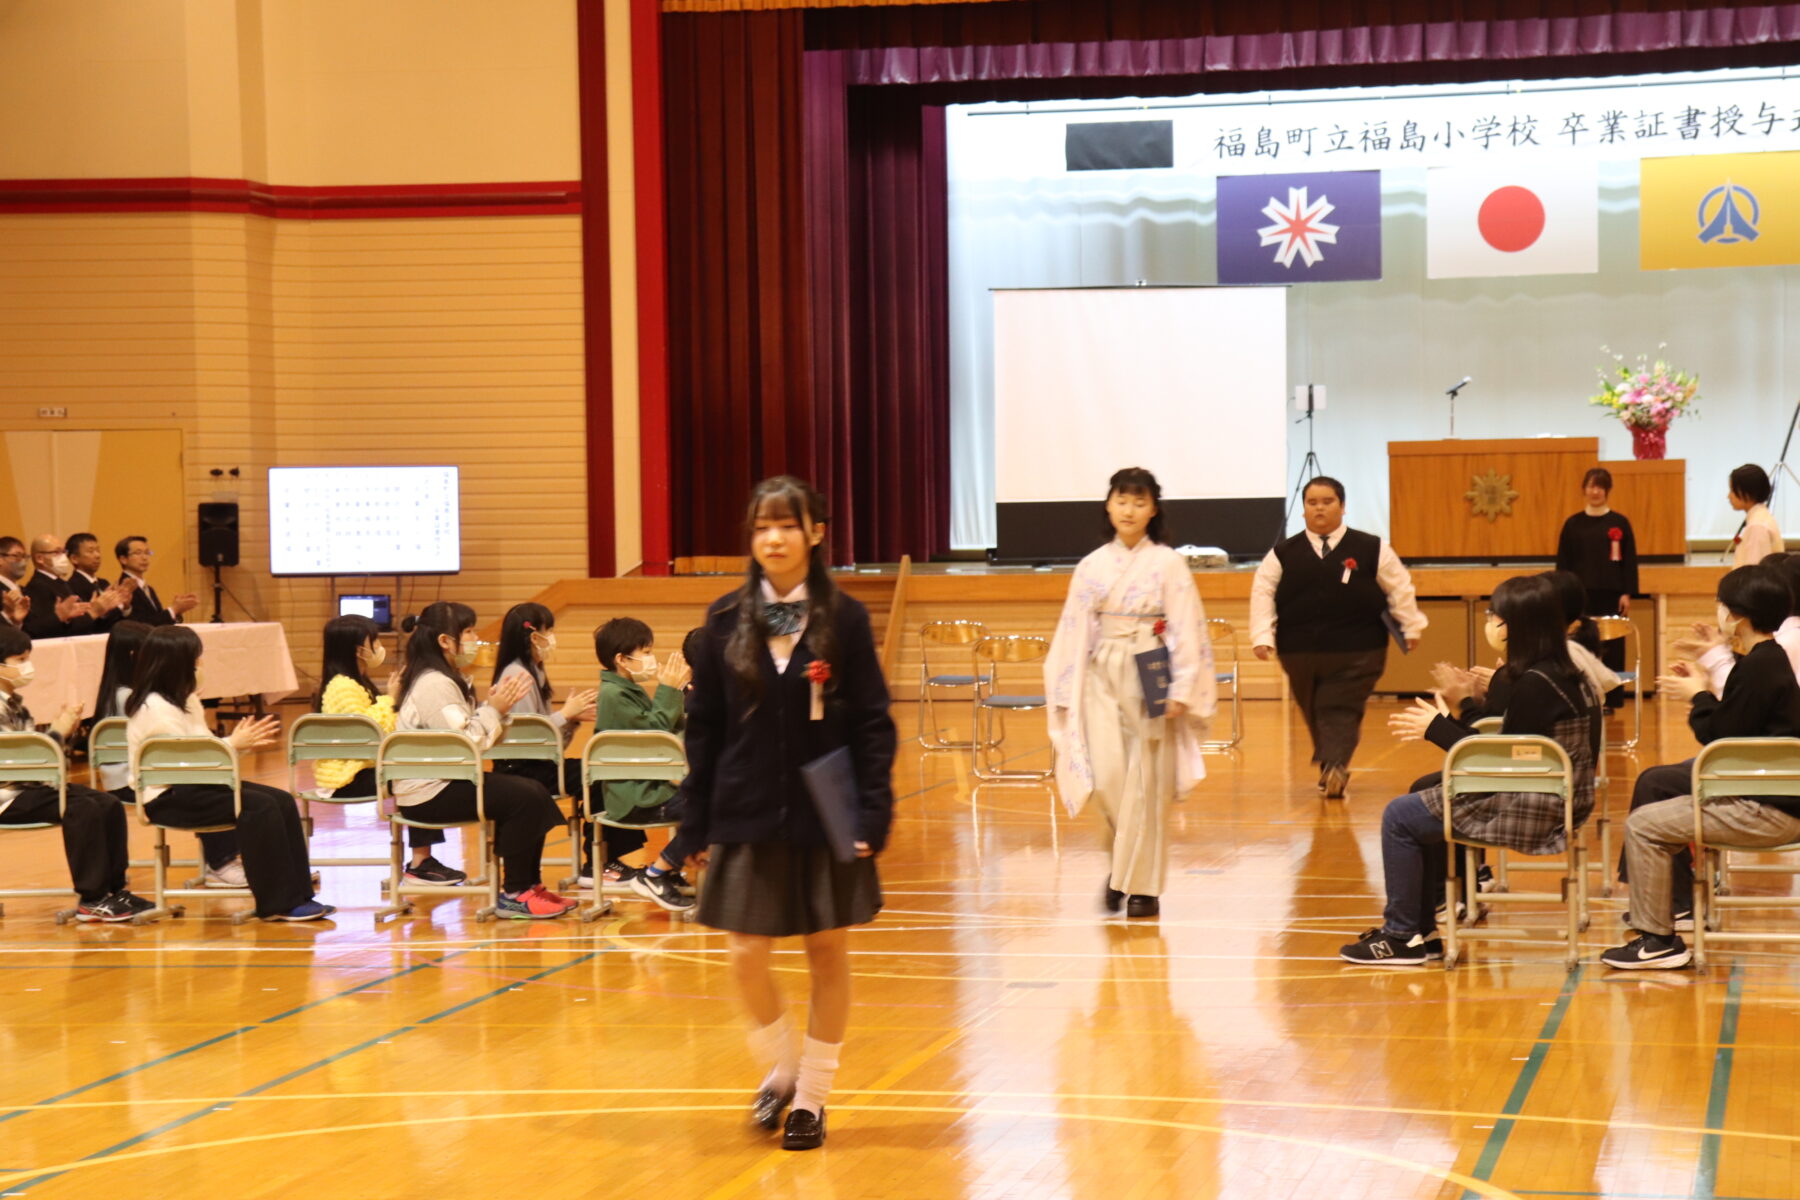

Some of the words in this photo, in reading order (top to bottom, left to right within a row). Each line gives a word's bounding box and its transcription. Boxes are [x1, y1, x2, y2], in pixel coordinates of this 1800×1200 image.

[1213, 115, 1541, 159] 福島町立福島小学校
[1369, 940, 1394, 959] N
